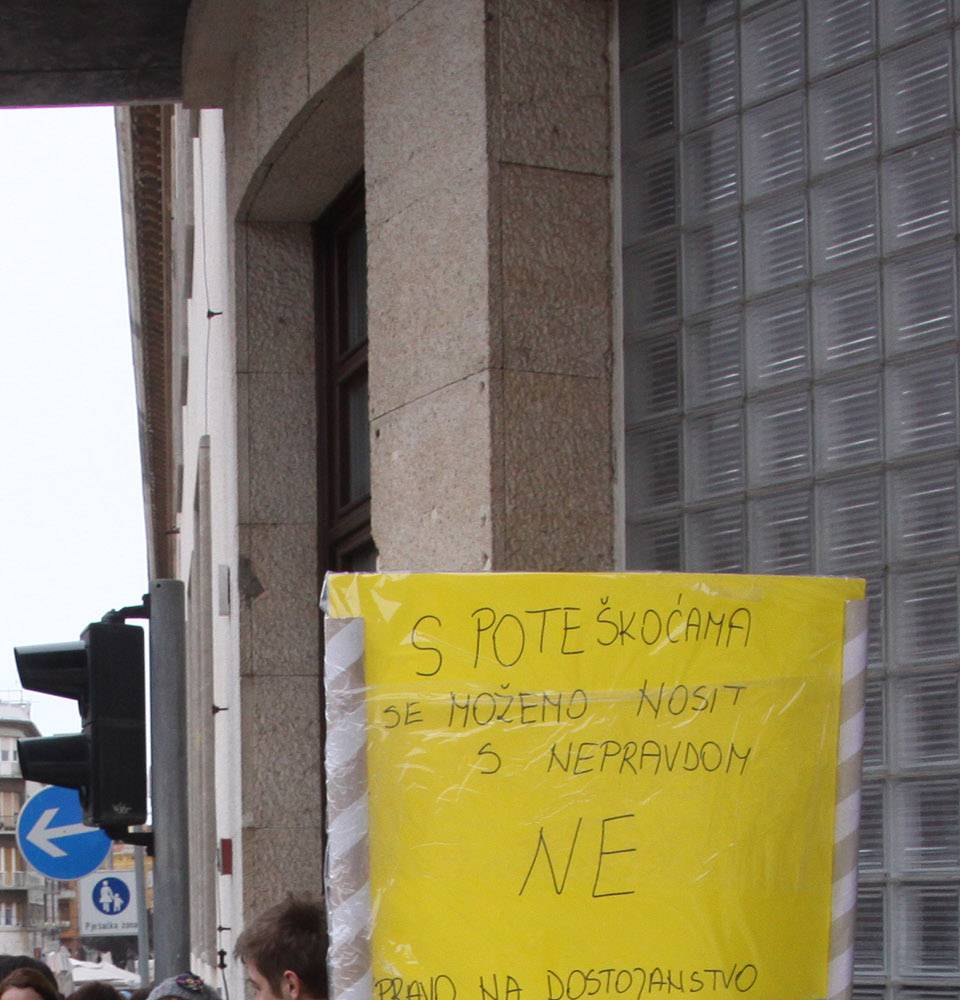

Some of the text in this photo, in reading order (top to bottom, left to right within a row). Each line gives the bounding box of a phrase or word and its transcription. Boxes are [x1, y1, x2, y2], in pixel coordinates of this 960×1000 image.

[411, 593, 753, 677] S POTEŠKOĆAMA
[383, 700, 425, 729] SE
[447, 681, 589, 729] MOŽEMO
[476, 738, 753, 776] S NEPRAVDOM
[518, 813, 638, 899] NE
